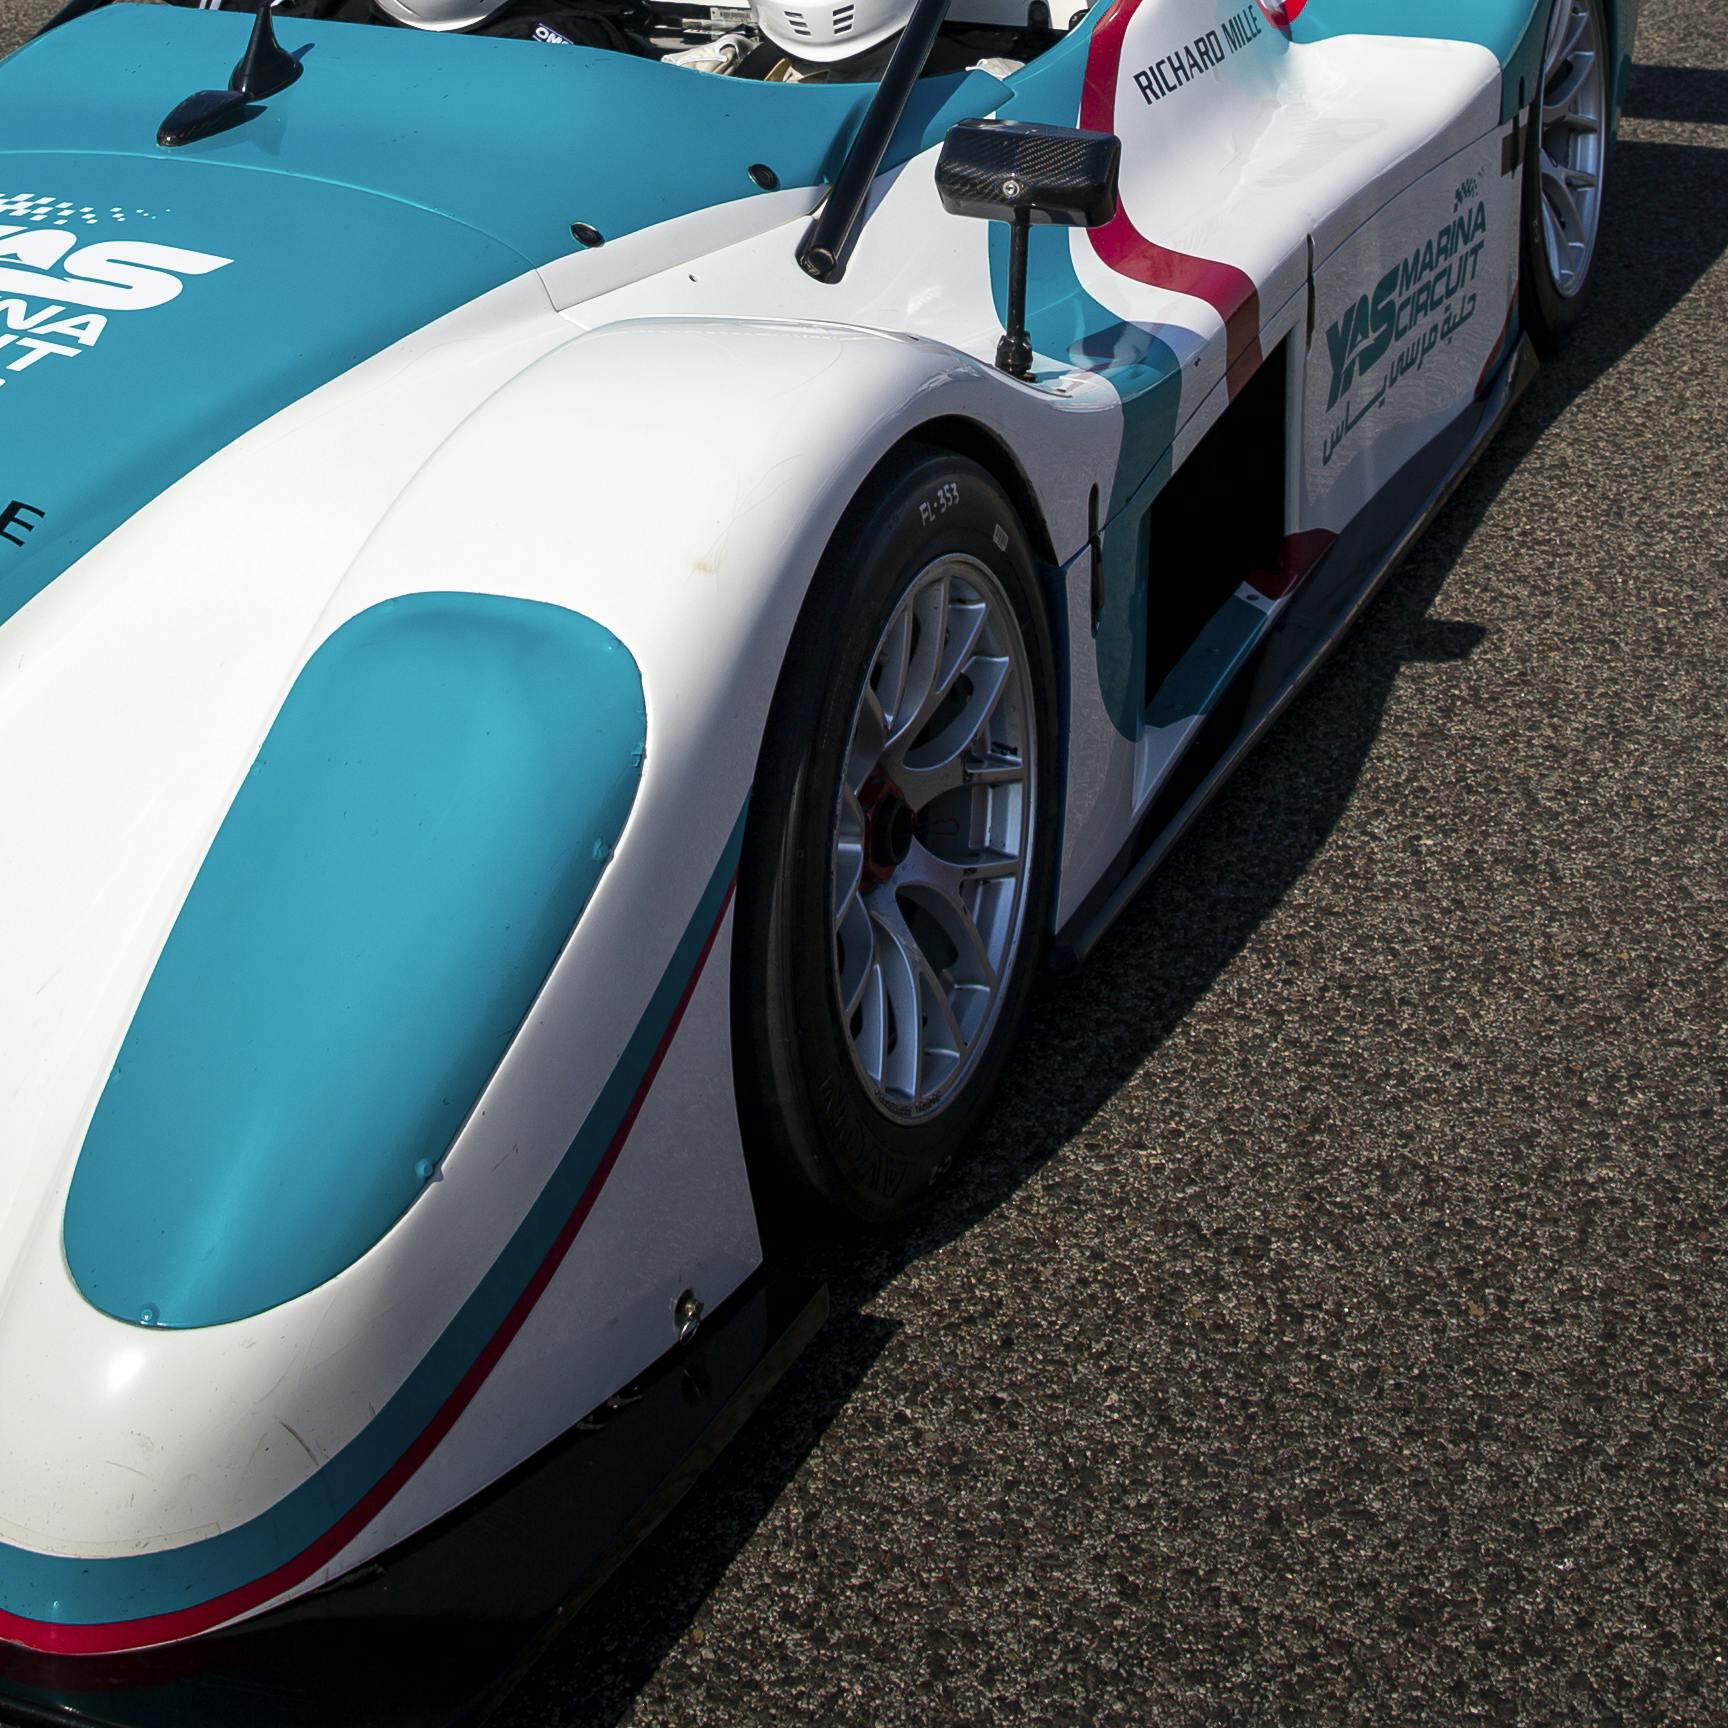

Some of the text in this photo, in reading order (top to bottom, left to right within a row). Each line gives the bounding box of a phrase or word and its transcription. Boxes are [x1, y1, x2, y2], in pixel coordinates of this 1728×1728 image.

[535, 26, 569, 45] OM
[1133, 5, 1262, 105] RICHARD MILLE
[1325, 201, 1486, 413] YAS MARINA
[1395, 239, 1484, 342] CIRCUIT
